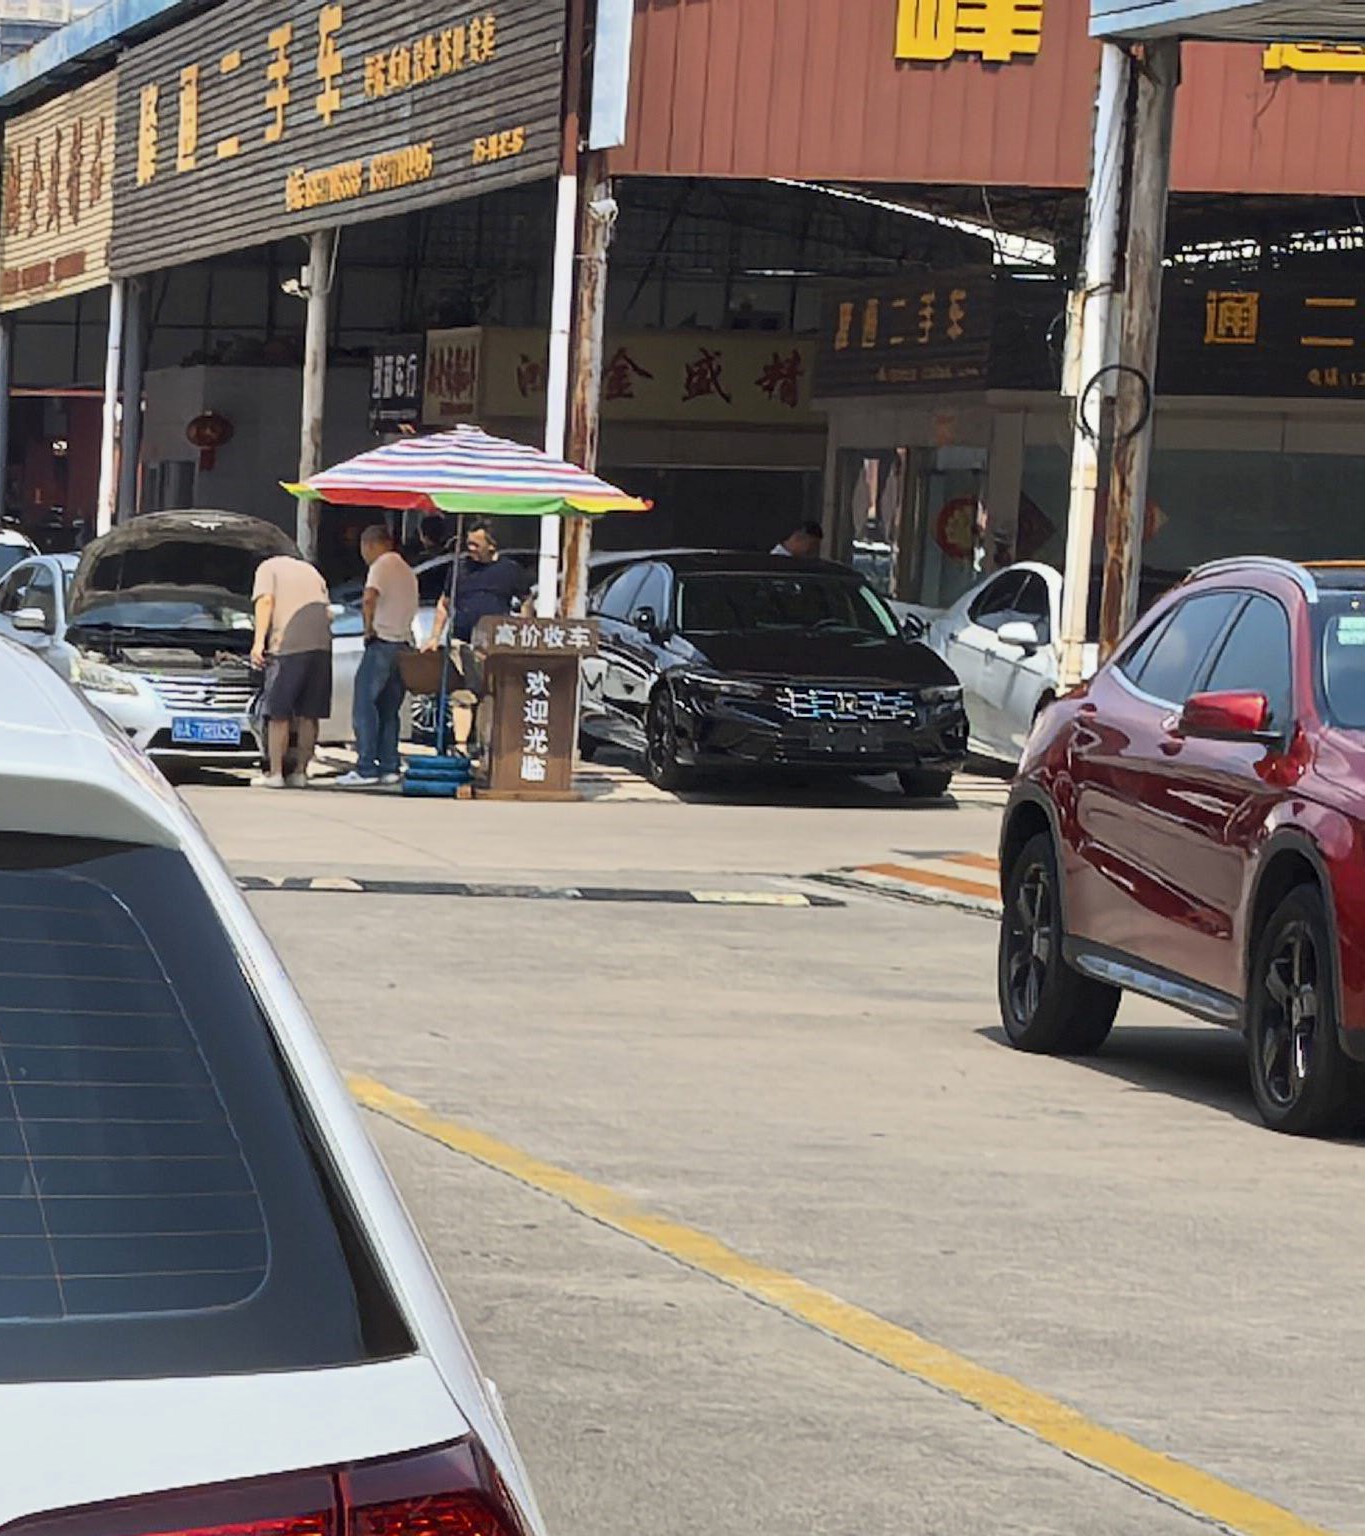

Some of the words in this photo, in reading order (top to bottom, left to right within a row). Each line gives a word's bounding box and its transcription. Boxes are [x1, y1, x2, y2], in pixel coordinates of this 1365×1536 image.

[494, 623, 591, 648] 高价收车
[520, 669, 551, 781] 欢迎光临
